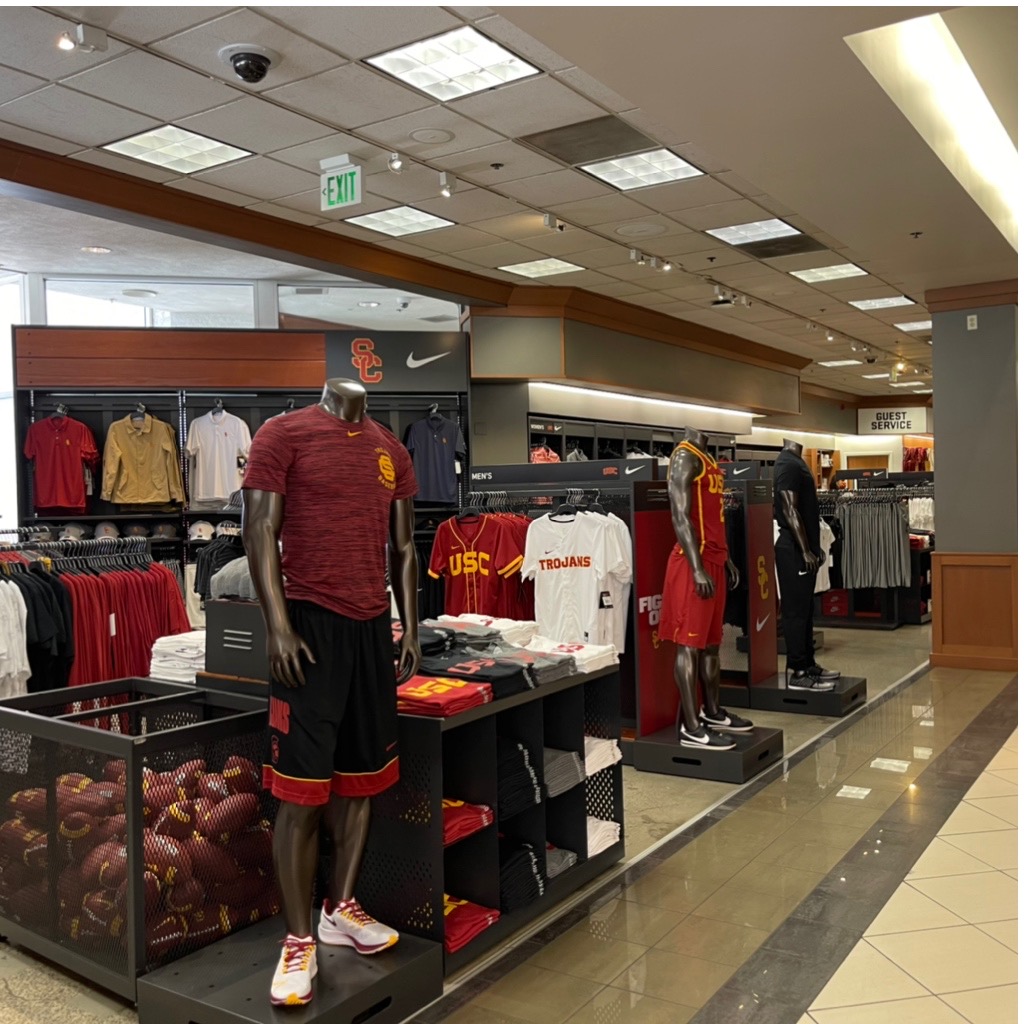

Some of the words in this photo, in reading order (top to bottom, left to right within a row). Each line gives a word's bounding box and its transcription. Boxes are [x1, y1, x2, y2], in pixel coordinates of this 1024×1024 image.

[327, 171, 357, 206] EXIT
[351, 337, 383, 383] SC
[871, 420, 912, 431] SERVICE
[875, 411, 907, 421] GUEST
[471, 472, 493, 480] MEN'S
[708, 473, 725, 494] US
[449, 551, 490, 576] USC
[539, 556, 591, 571] TROJANS
[638, 593, 662, 614] FIG
